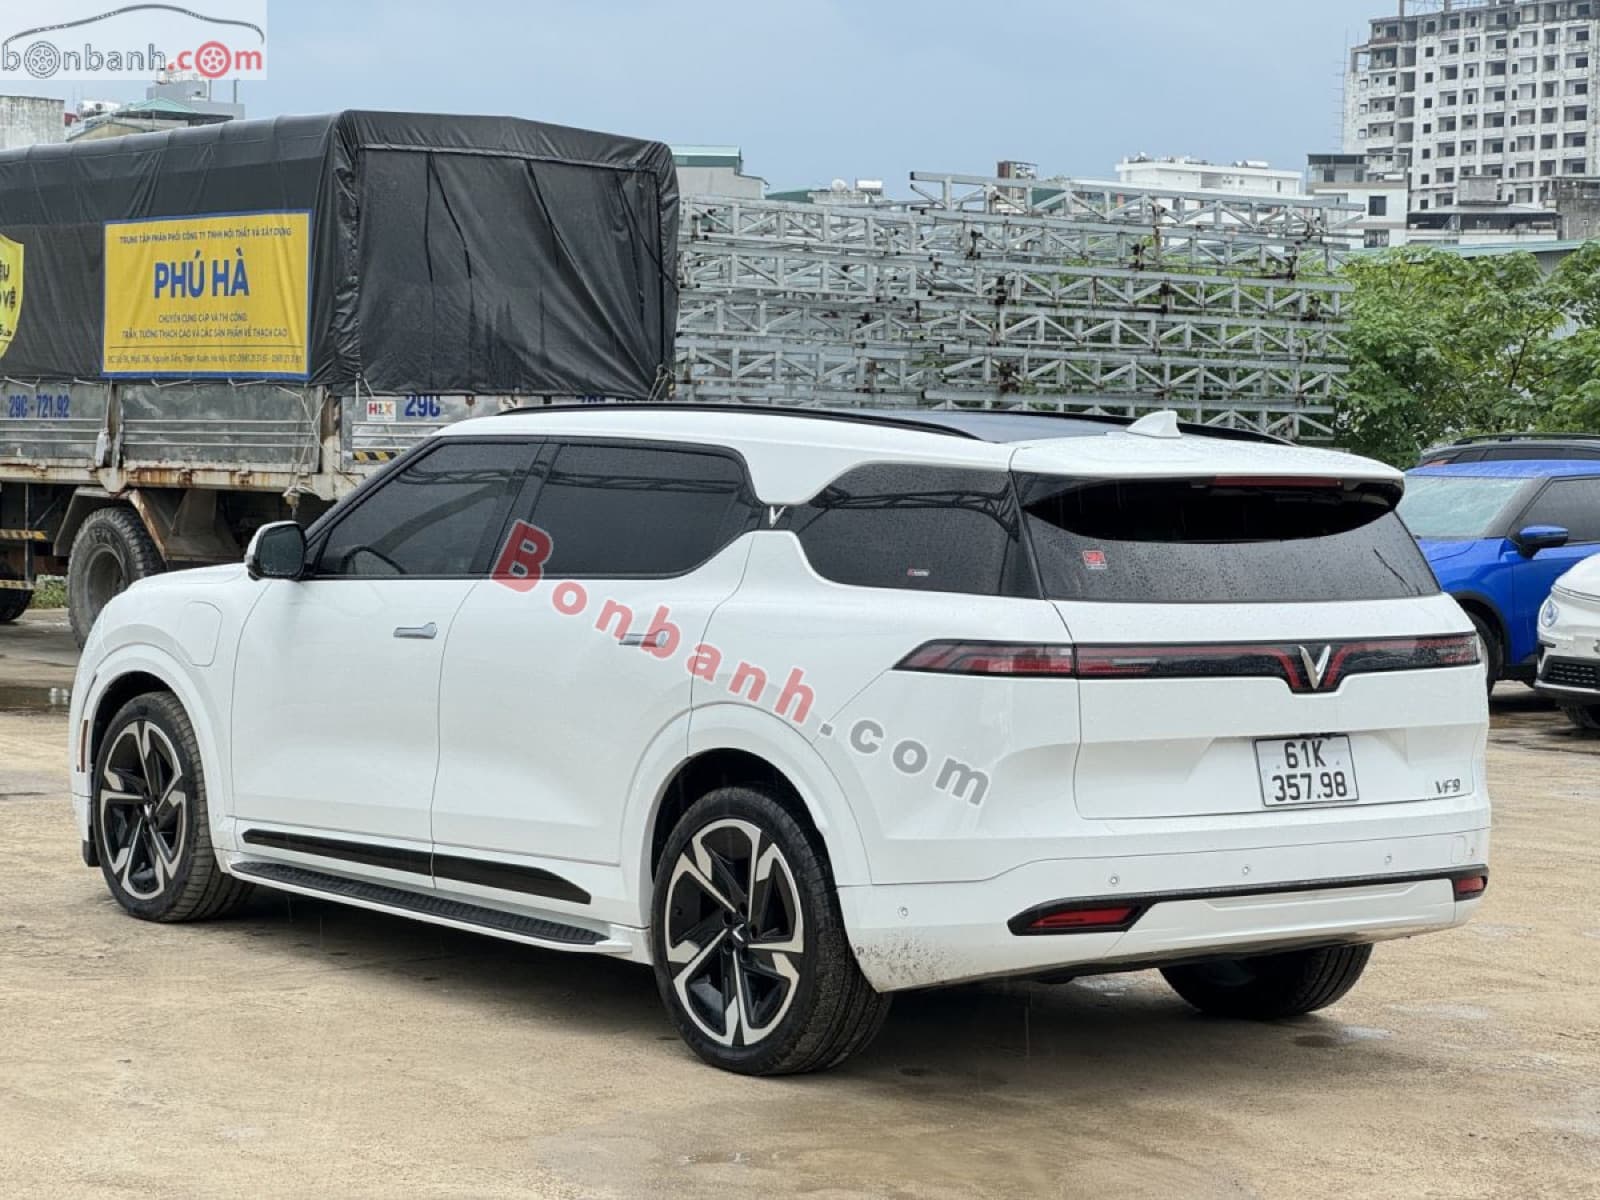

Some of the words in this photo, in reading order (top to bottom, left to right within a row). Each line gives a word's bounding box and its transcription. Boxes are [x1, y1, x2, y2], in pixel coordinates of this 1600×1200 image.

[154, 249, 205, 298] PHÚ
[211, 247, 250, 297] HÀ
[404, 395, 441, 417] 29C
[1284, 740, 1327, 769] 61K
[1271, 771, 1348, 802] 357.98
